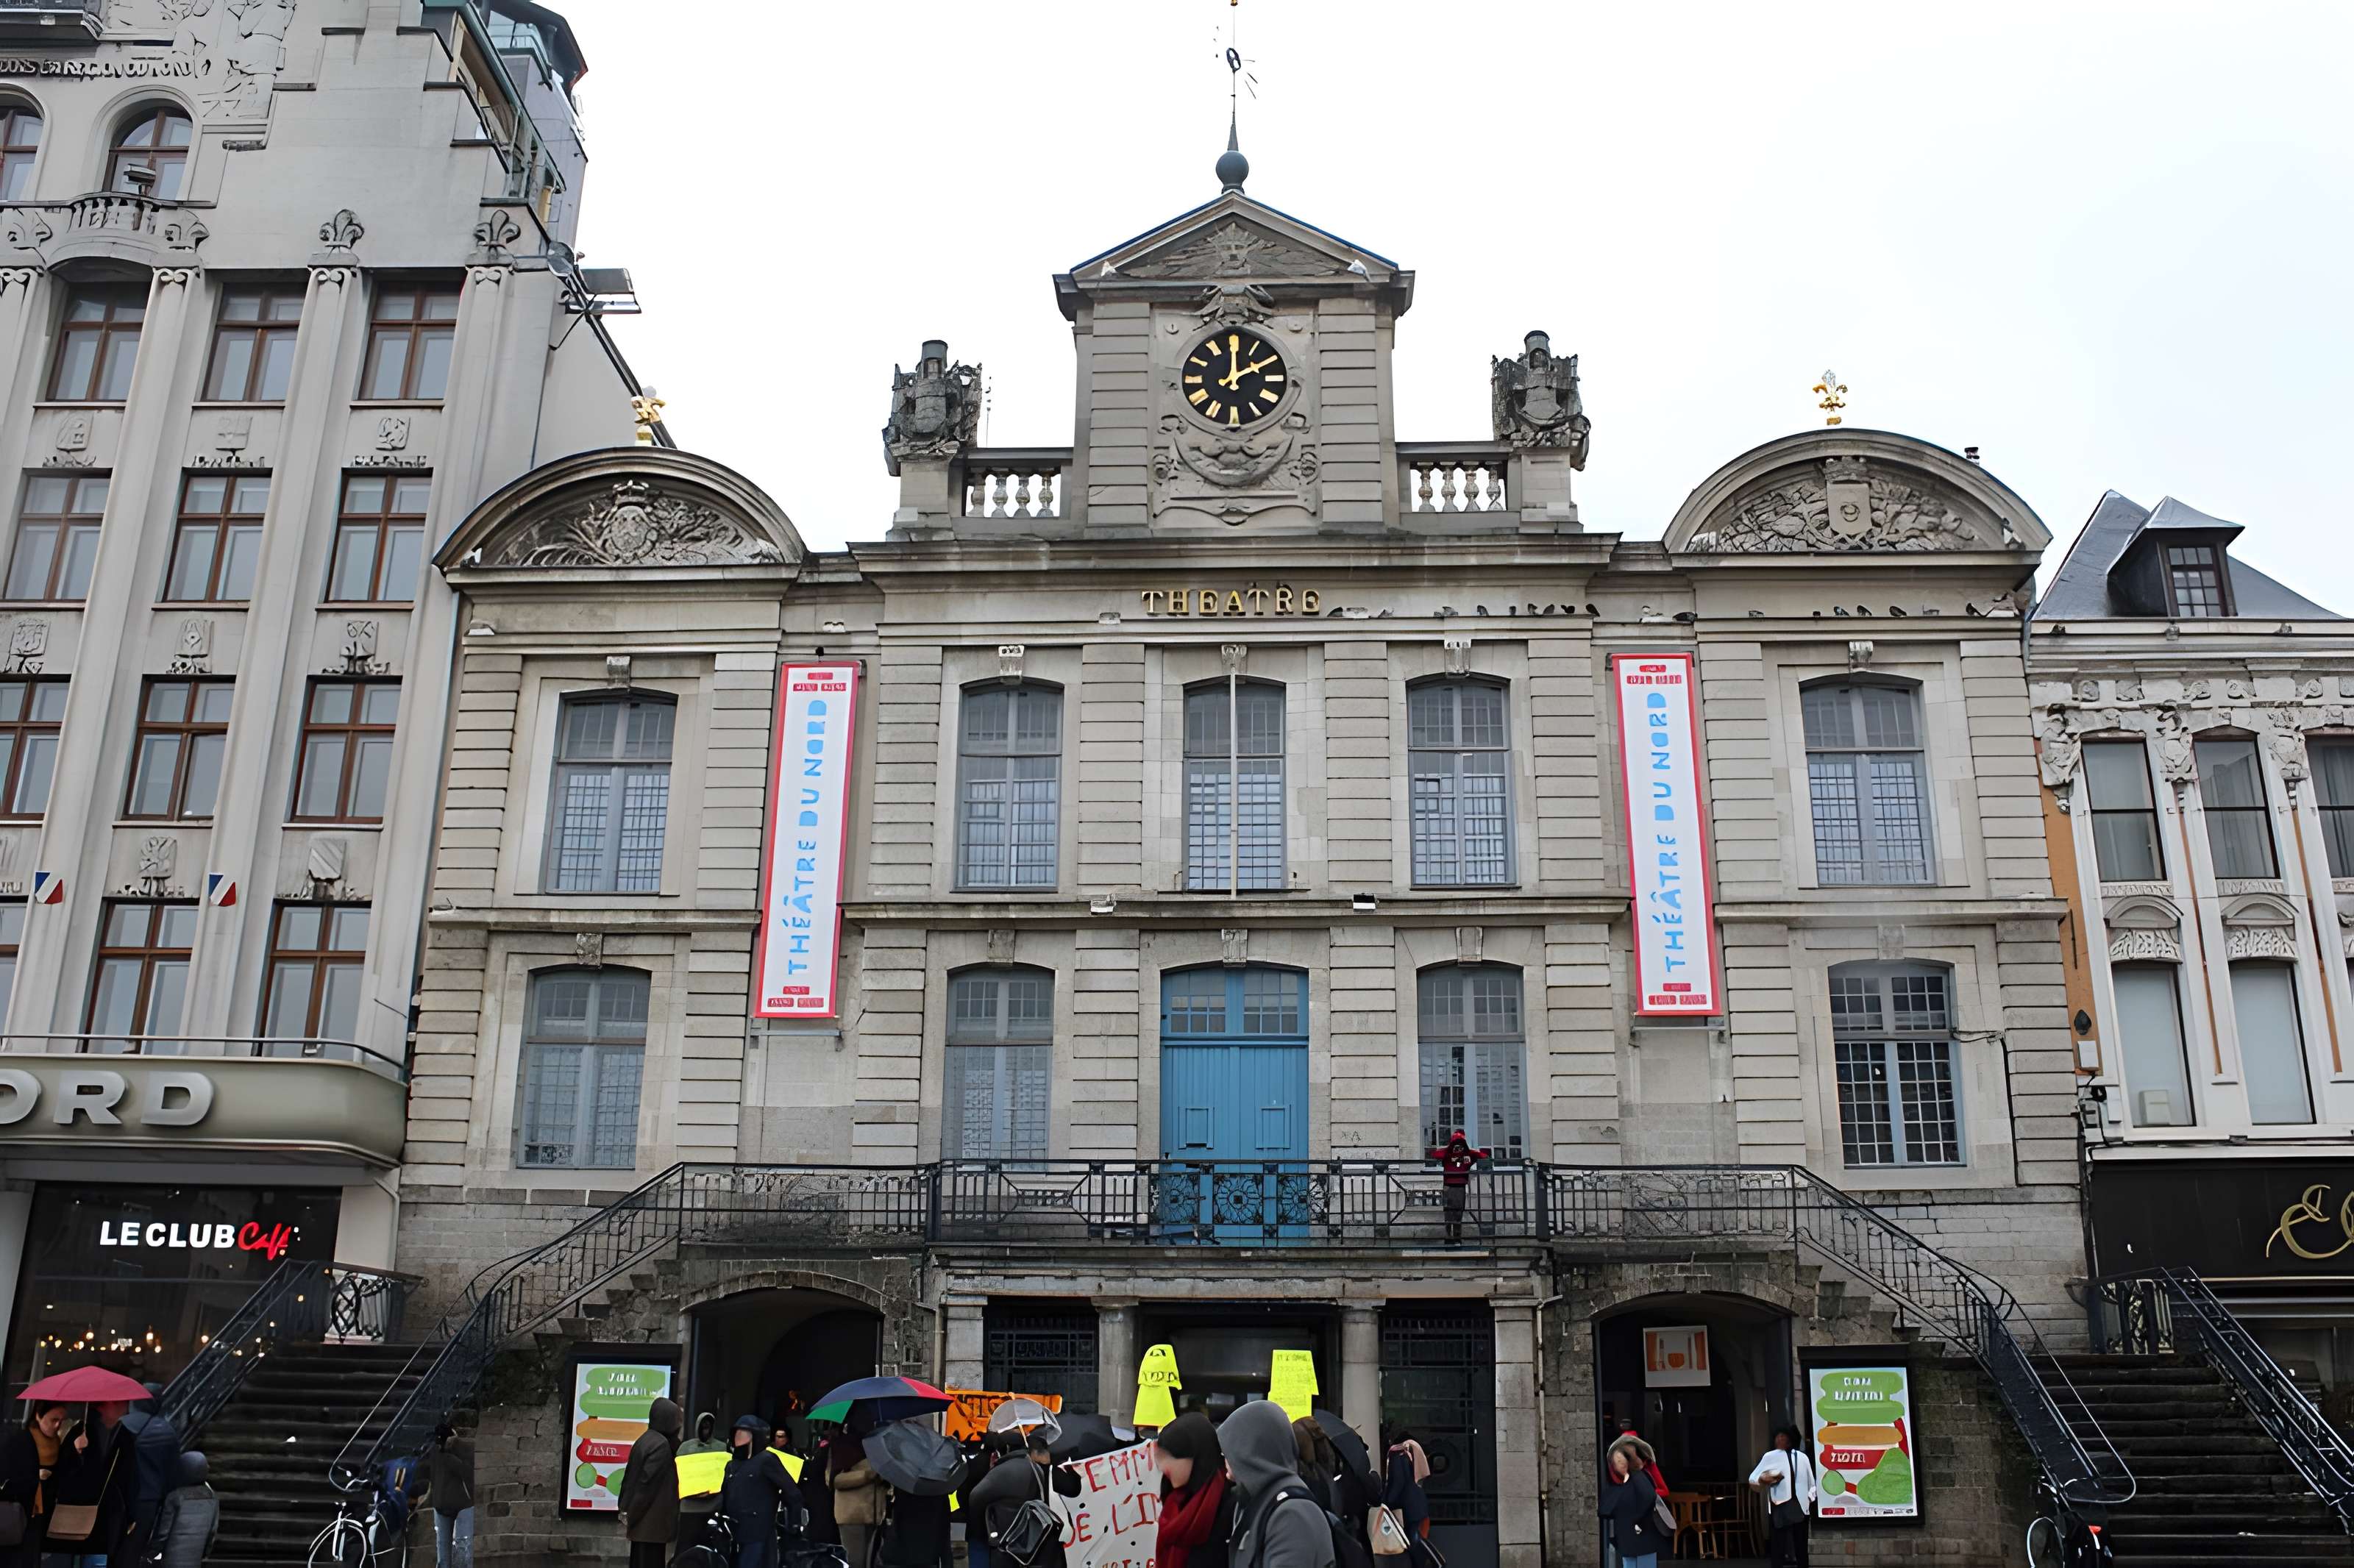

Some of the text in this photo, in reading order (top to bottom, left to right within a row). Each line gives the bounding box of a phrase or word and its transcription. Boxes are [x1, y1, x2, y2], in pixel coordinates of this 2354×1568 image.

[800, 700, 827, 777] NORD
[1647, 692, 1672, 770] NORD
[797, 788, 820, 827] DU
[1653, 782, 1676, 822] DU
[782, 840, 817, 976] THÉÂTRE
[1649, 835, 1687, 972] THÉÂTRE
[99, 1221, 141, 1246] LE
[146, 1222, 235, 1249] CLUB
